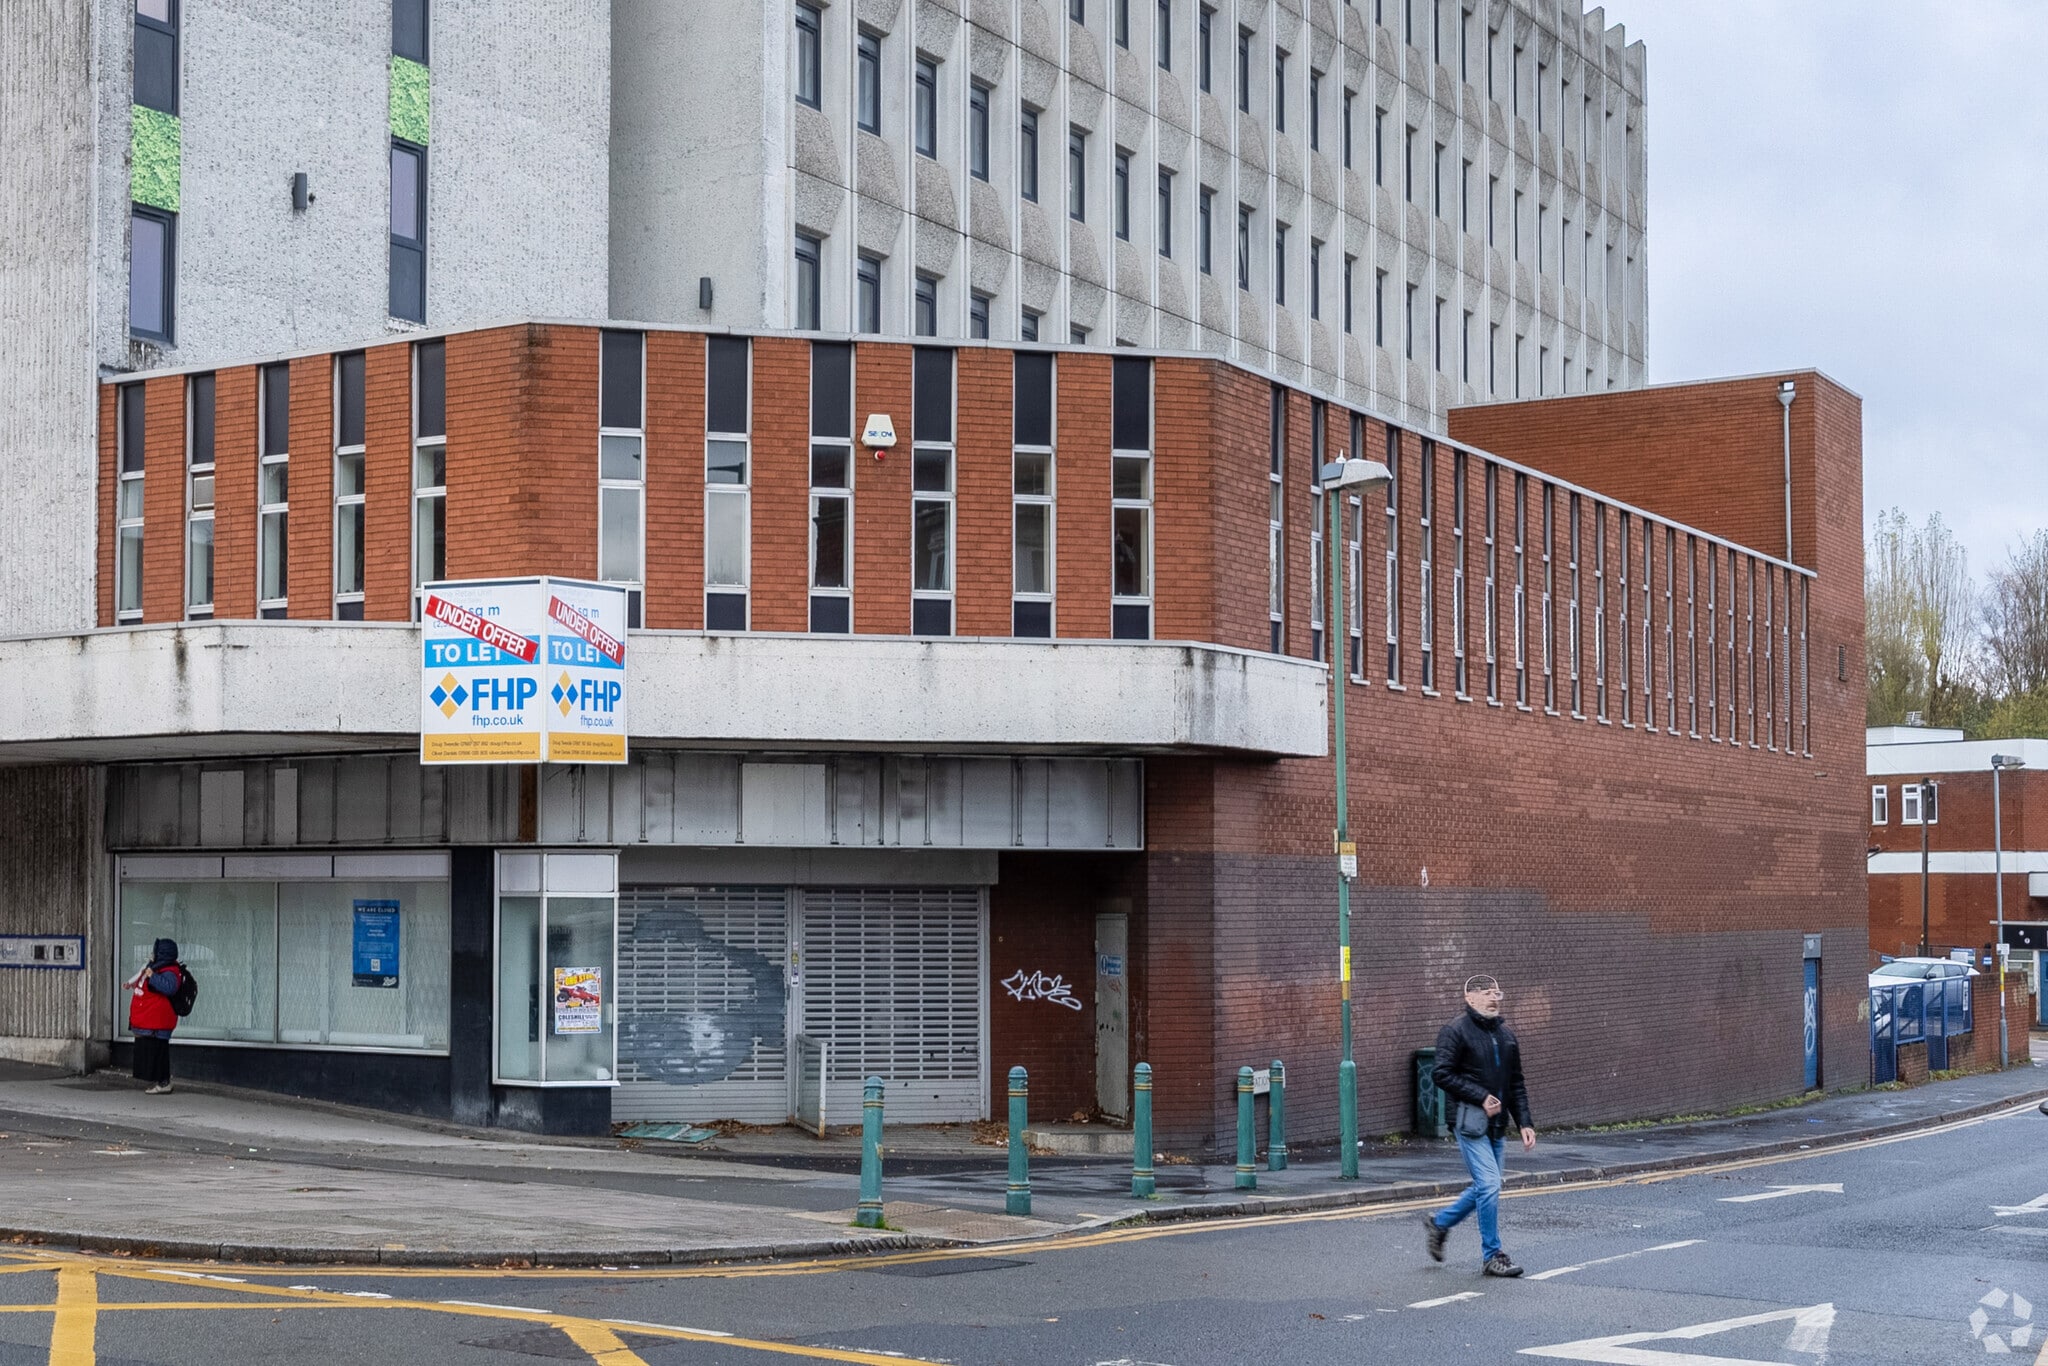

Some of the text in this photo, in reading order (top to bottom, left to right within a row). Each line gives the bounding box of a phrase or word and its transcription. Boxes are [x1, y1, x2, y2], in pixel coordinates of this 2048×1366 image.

[435, 600, 526, 657] UNDER OFFER
[556, 601, 618, 659] UNDER OFFER
[432, 644, 461, 663] TO
[552, 642, 573, 661] TO
[472, 677, 538, 711] FHP
[580, 679, 622, 712] FHP
[472, 714, 523, 729] fhp.co.uk
[580, 714, 614, 729] fhp.co.uk
